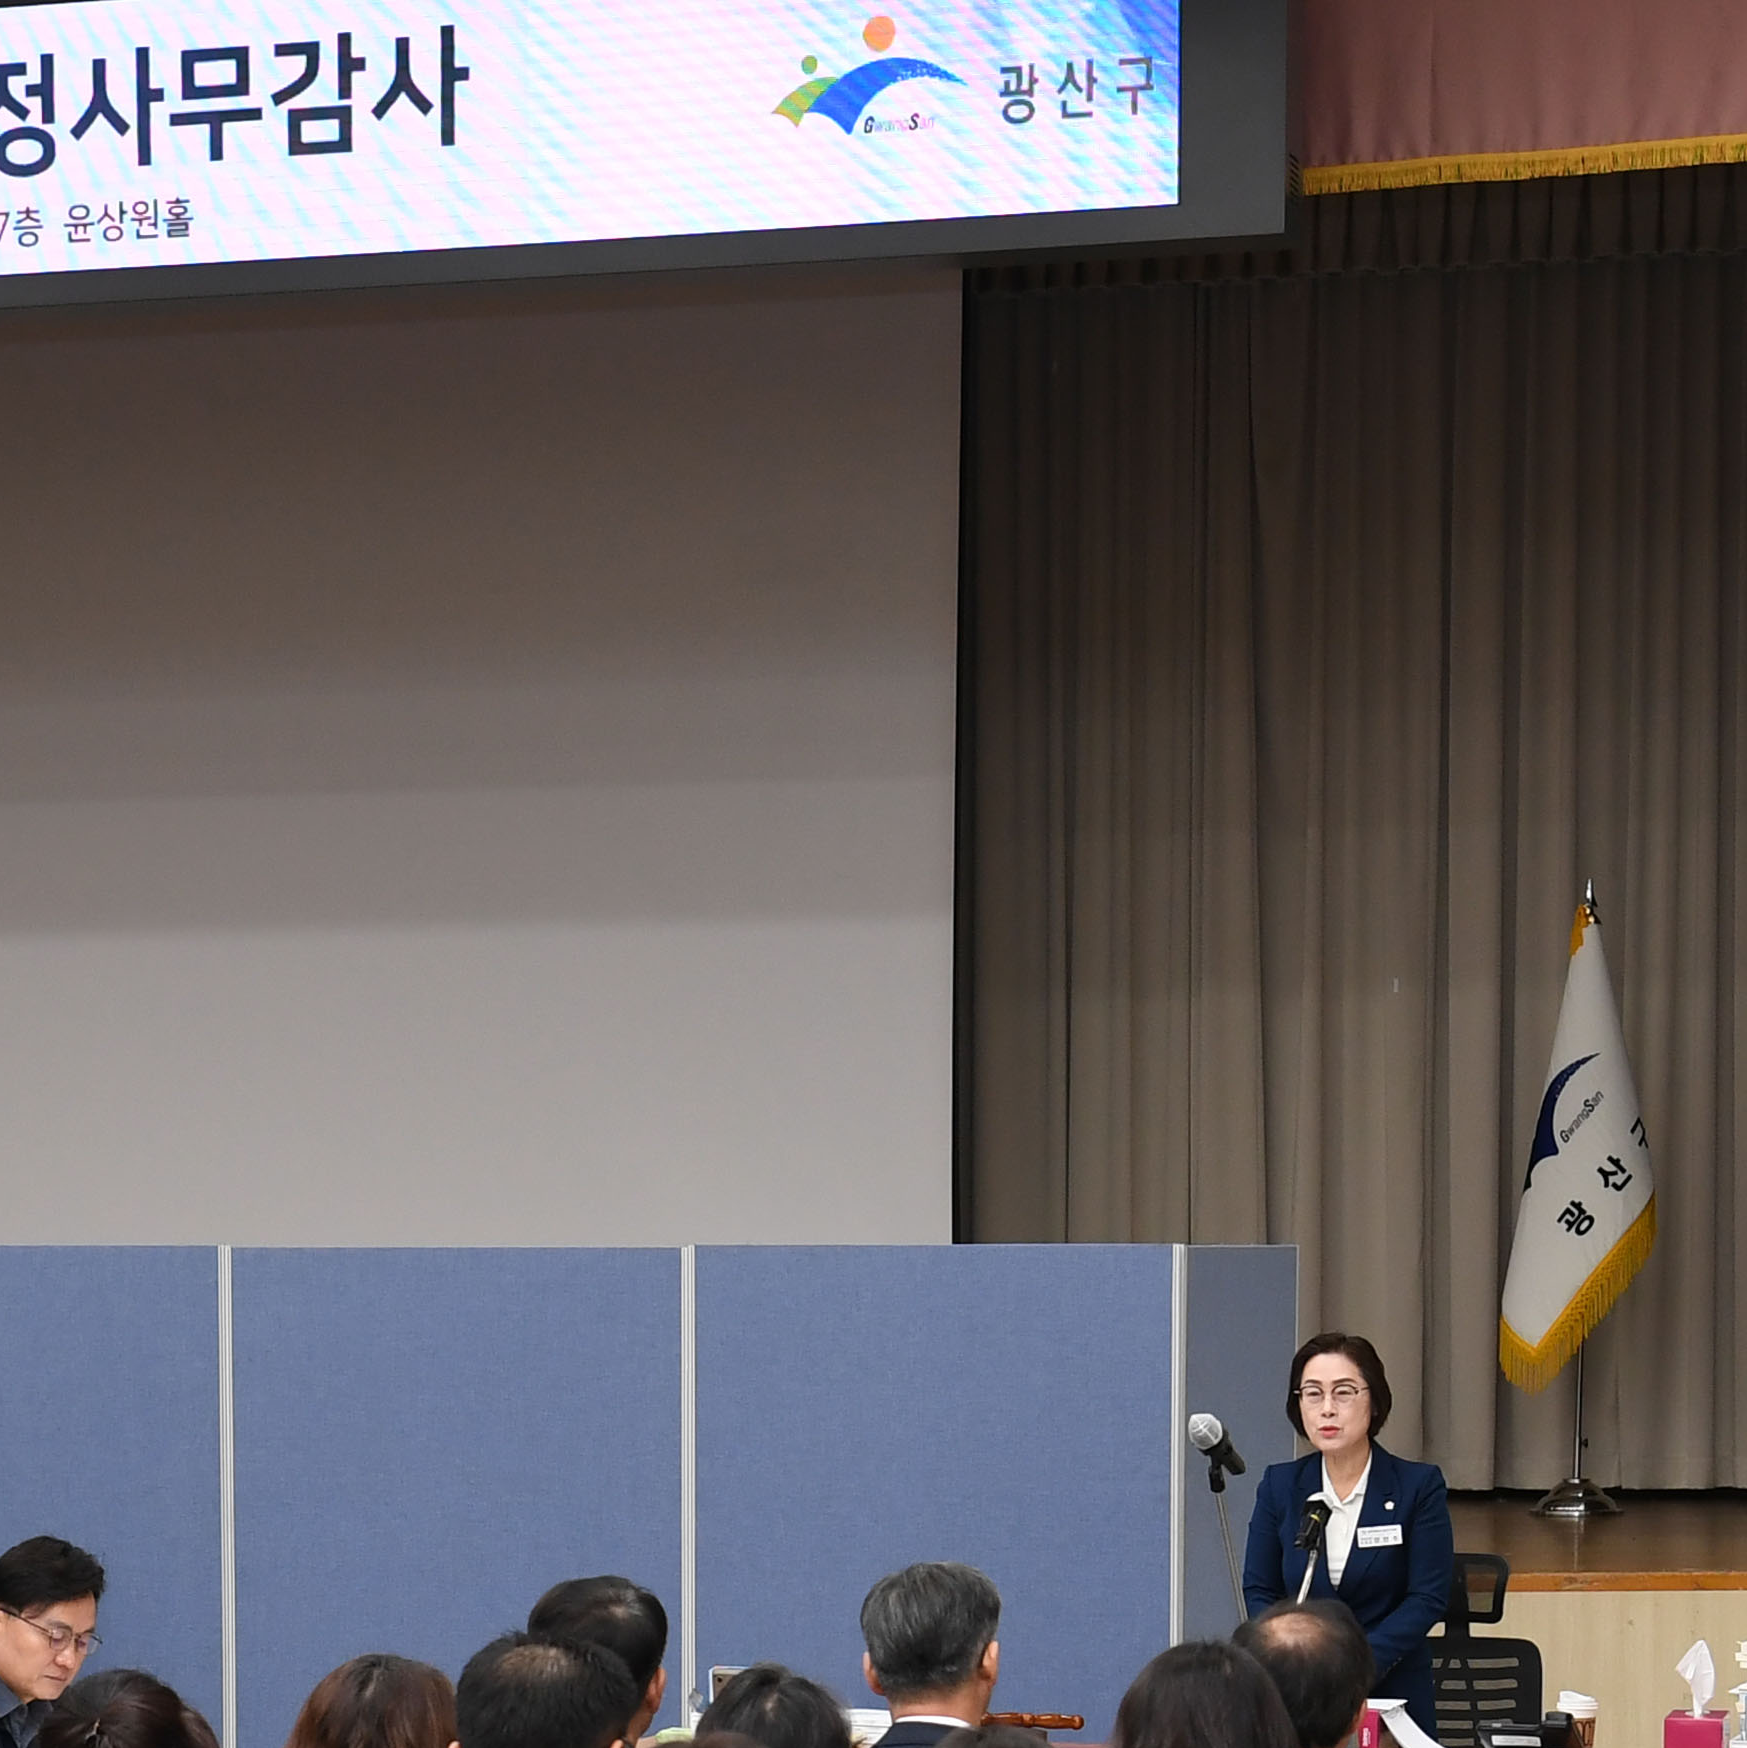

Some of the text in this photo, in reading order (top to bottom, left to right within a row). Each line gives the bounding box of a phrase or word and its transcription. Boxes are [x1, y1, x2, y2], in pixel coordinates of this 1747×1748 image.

[999, 56, 1154, 124] 광산구
[63, 197, 194, 244] 윤상원홀
[1559, 1090, 1605, 1144] GwangSan
